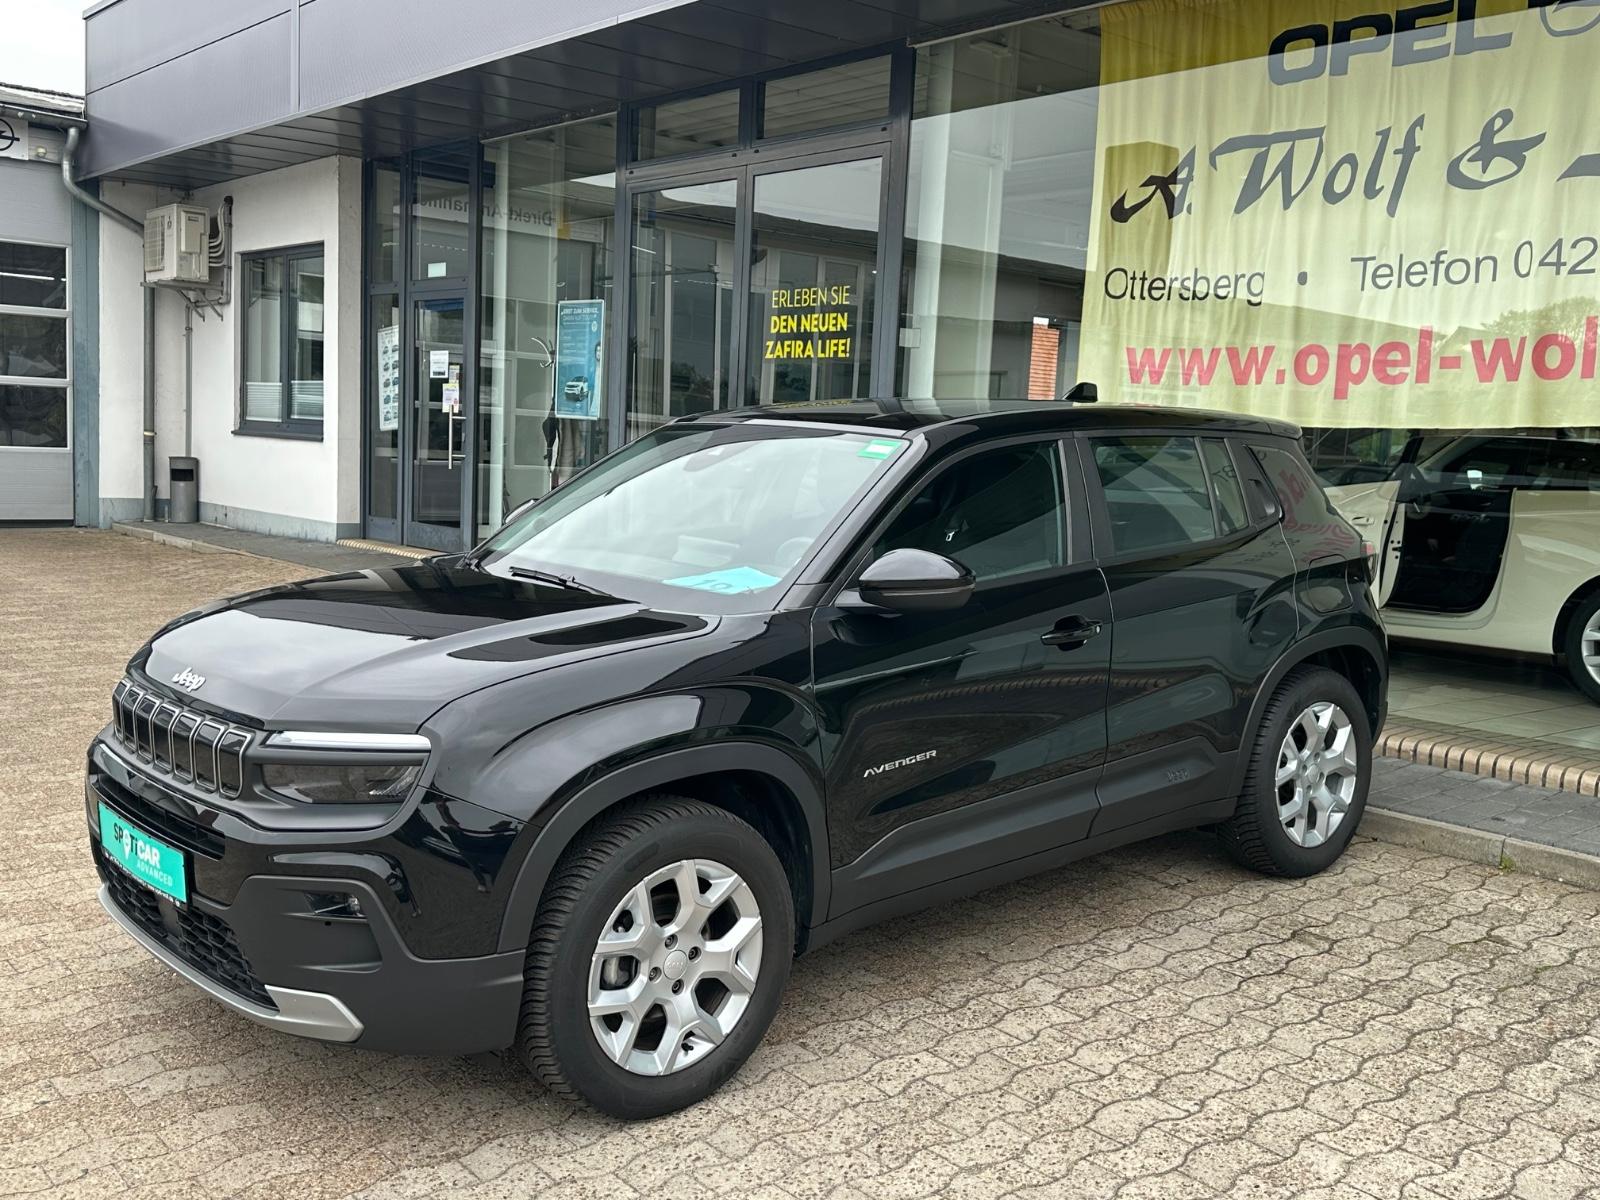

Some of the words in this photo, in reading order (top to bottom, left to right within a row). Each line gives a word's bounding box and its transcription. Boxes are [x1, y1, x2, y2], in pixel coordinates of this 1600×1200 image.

[1267, 0, 1513, 86] OPEL
[1209, 113, 1425, 218] Wolf
[1446, 108, 1547, 191] &
[1104, 266, 1266, 307] Ottersberg
[1351, 250, 1498, 292] Telefon
[1513, 236, 1599, 279] 042
[771, 287, 828, 309] ERLEBEN
[830, 285, 851, 306] SIE
[770, 314, 798, 334] DEN
[800, 312, 849, 333] NEUEN
[765, 339, 814, 359] ZAFIRA
[817, 337, 851, 358] LIFE!
[1125, 315, 1599, 401] www.opel-wol
[172, 667, 206, 693] Jeep
[863, 749, 937, 778] AVENGER
[136, 860, 174, 887] ADVANCED
